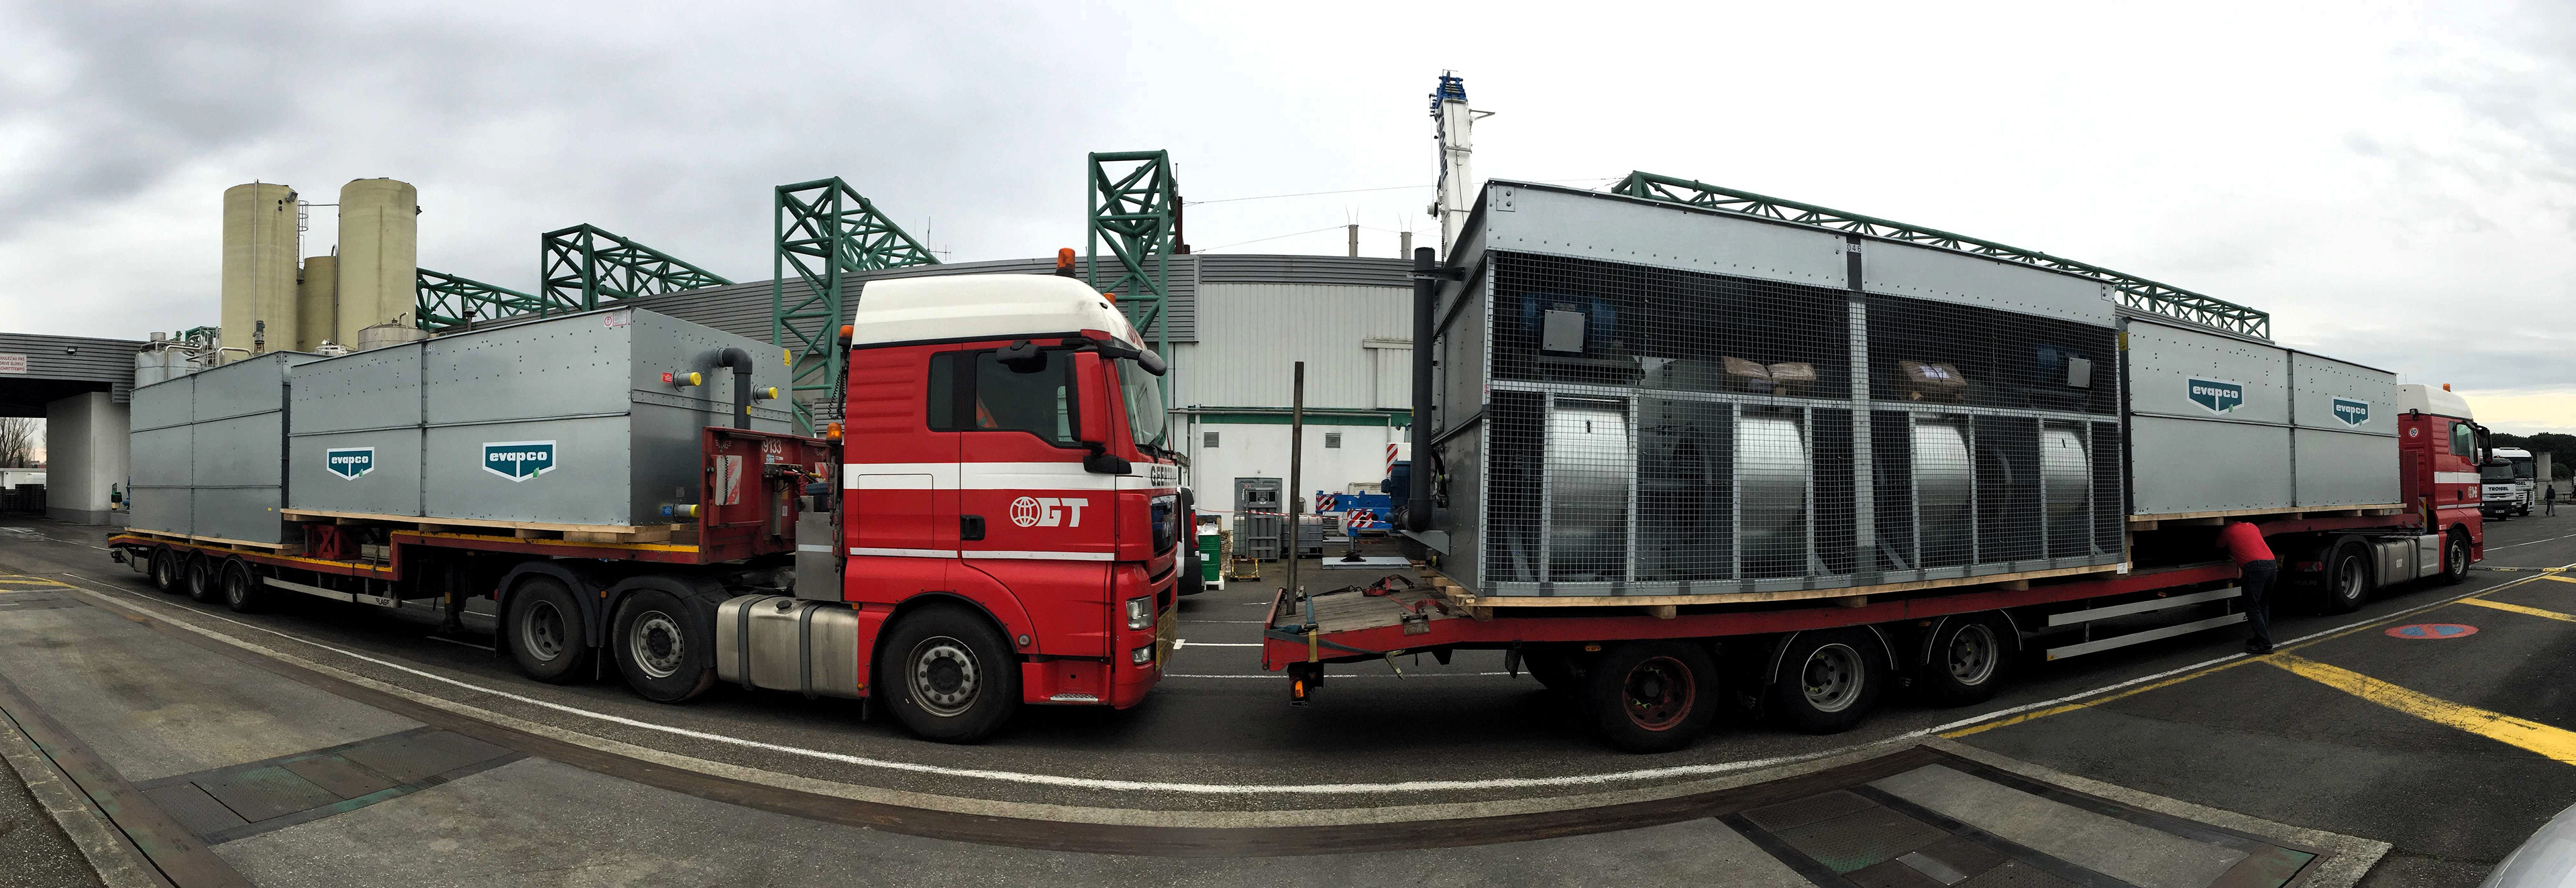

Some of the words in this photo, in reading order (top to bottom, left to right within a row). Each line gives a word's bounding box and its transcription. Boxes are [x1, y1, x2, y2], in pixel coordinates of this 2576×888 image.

[1847, 243, 1862, 253] 046
[2192, 386, 2239, 402] evapco
[2336, 404, 2366, 419] evapco
[331, 456, 369, 467] evapco
[490, 452, 547, 467] evapco
[1034, 497, 1089, 528] GT
